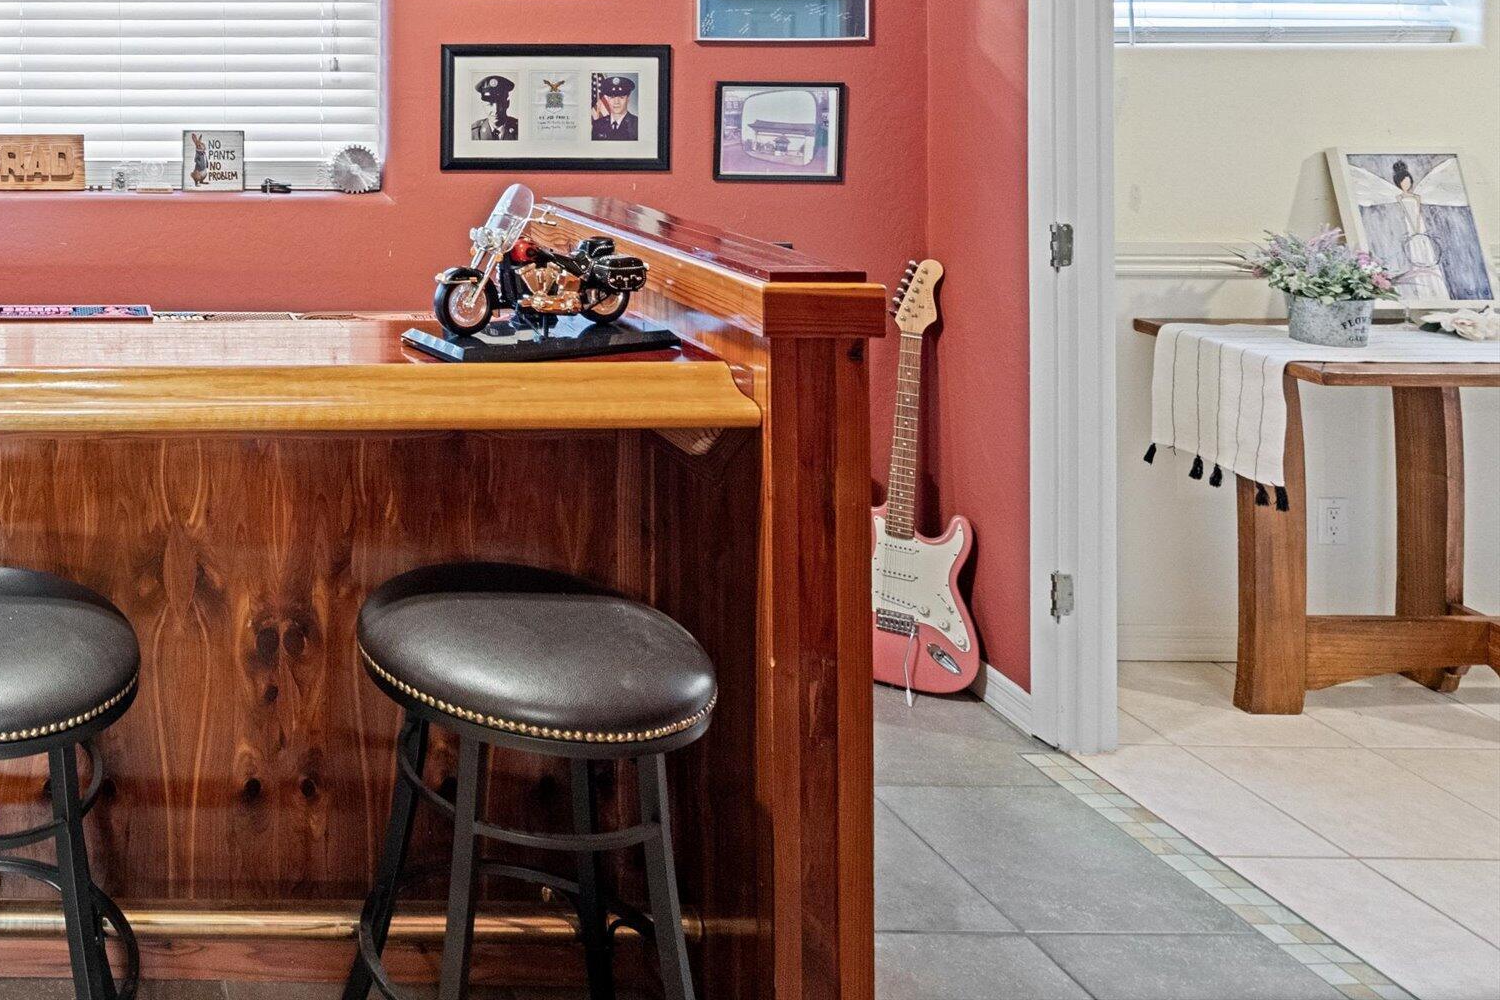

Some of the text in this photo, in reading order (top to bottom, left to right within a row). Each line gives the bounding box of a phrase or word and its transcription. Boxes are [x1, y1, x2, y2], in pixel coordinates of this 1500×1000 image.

[208, 140, 221, 150] NO
[208, 150, 236, 161] PANTS
[209, 161, 222, 171] NO
[208, 171, 239, 181] PROBLEM
